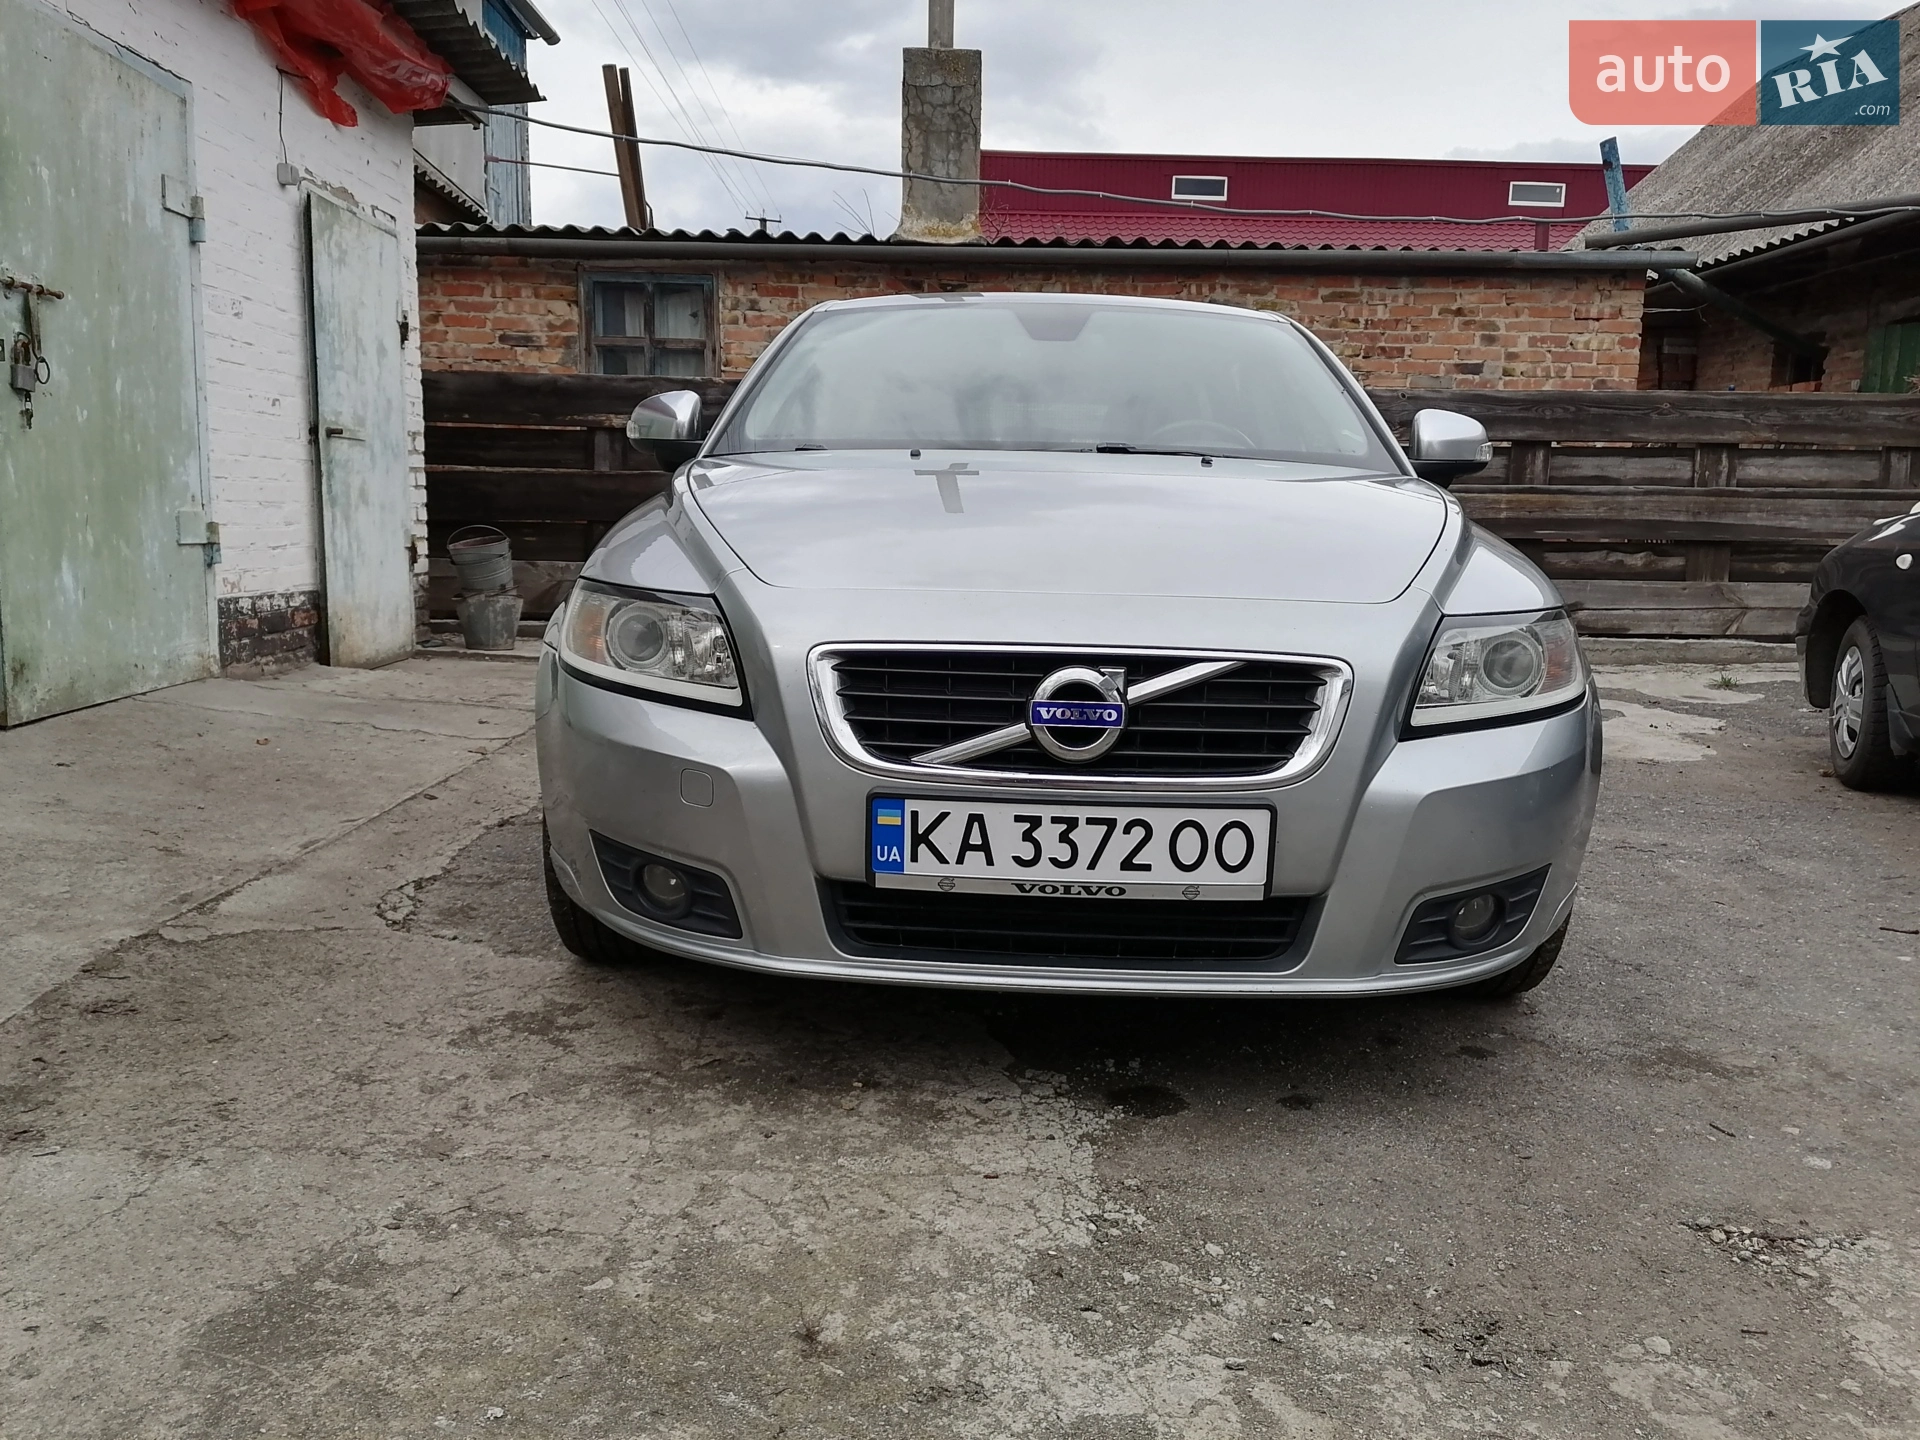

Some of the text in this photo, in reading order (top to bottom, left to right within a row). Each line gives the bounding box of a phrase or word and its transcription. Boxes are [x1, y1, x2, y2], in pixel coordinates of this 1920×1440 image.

[1036, 706, 1118, 721] VOLVO
[910, 810, 995, 866] KA
[1011, 814, 1153, 872] 3372
[877, 845, 901, 862] UA
[1011, 882, 1127, 897] VOLVO
